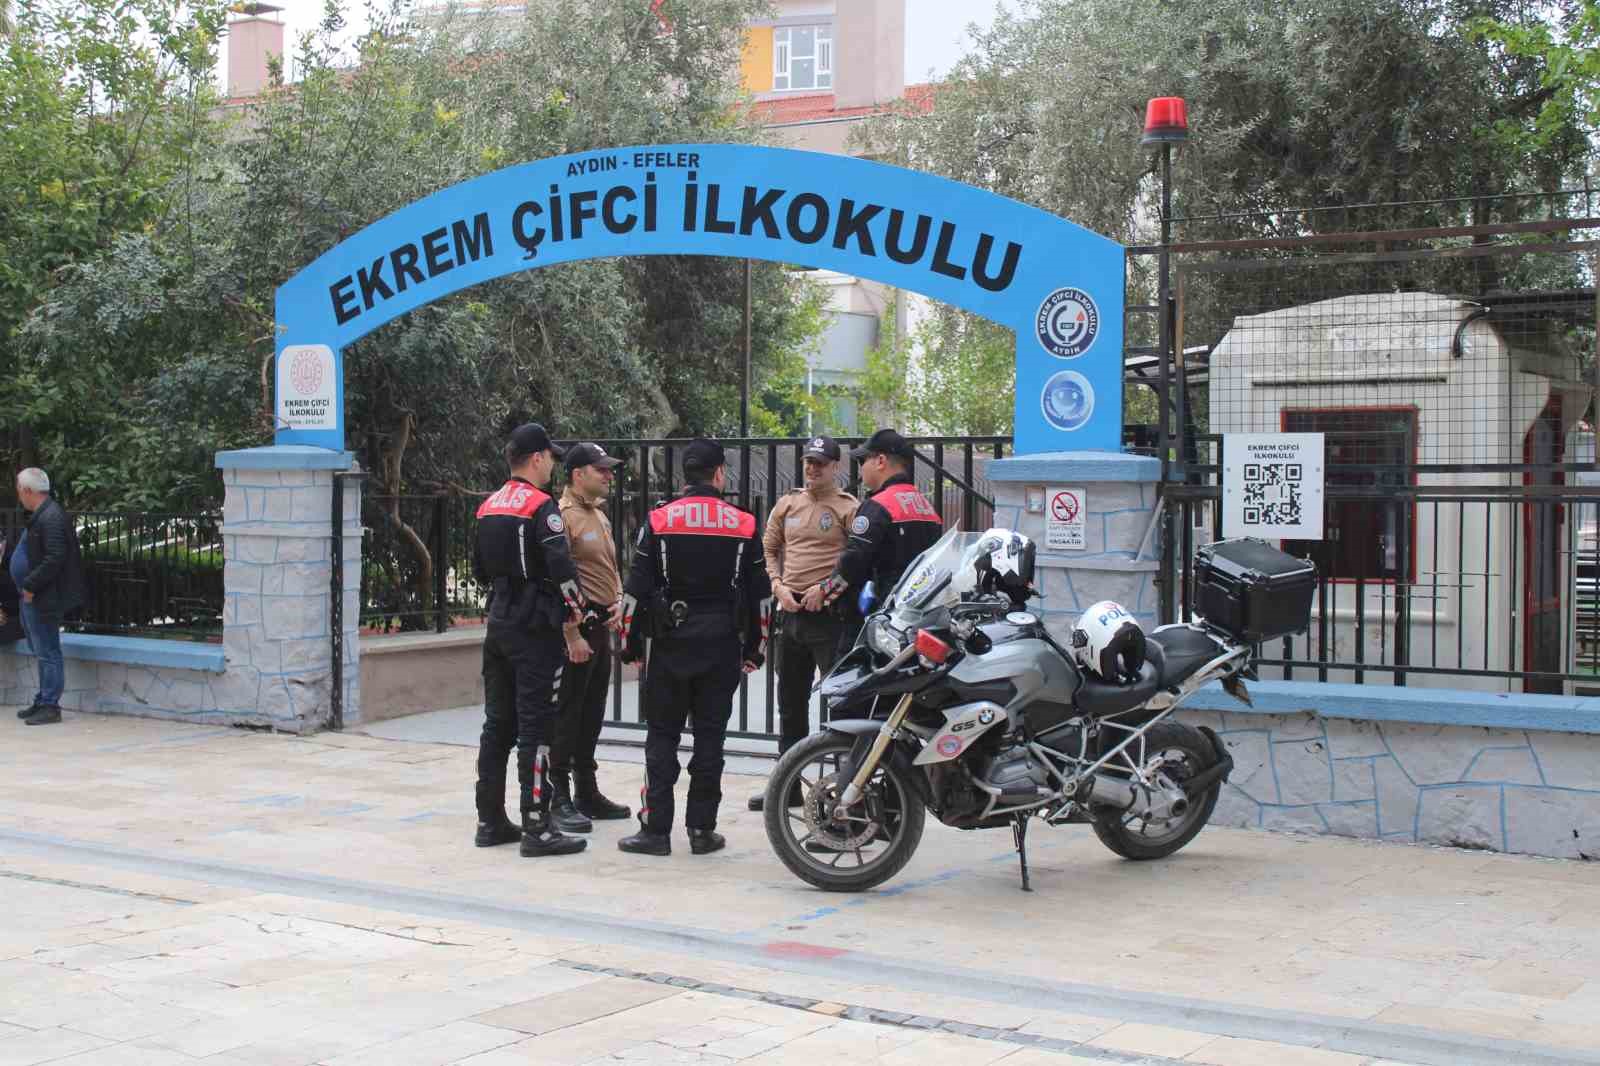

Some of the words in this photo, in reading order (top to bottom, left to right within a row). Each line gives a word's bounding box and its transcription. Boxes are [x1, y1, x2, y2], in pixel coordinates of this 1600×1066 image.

[567, 156, 617, 176] AYDIN
[633, 153, 700, 168] EFELER
[328, 212, 494, 326] EKREM
[512, 172, 657, 260] ÇİFCİ
[683, 171, 1023, 292] İLKOKULU
[285, 399, 309, 407] EKREM
[289, 408, 325, 416] İLKOKULU
[951, 719, 977, 732] GS
